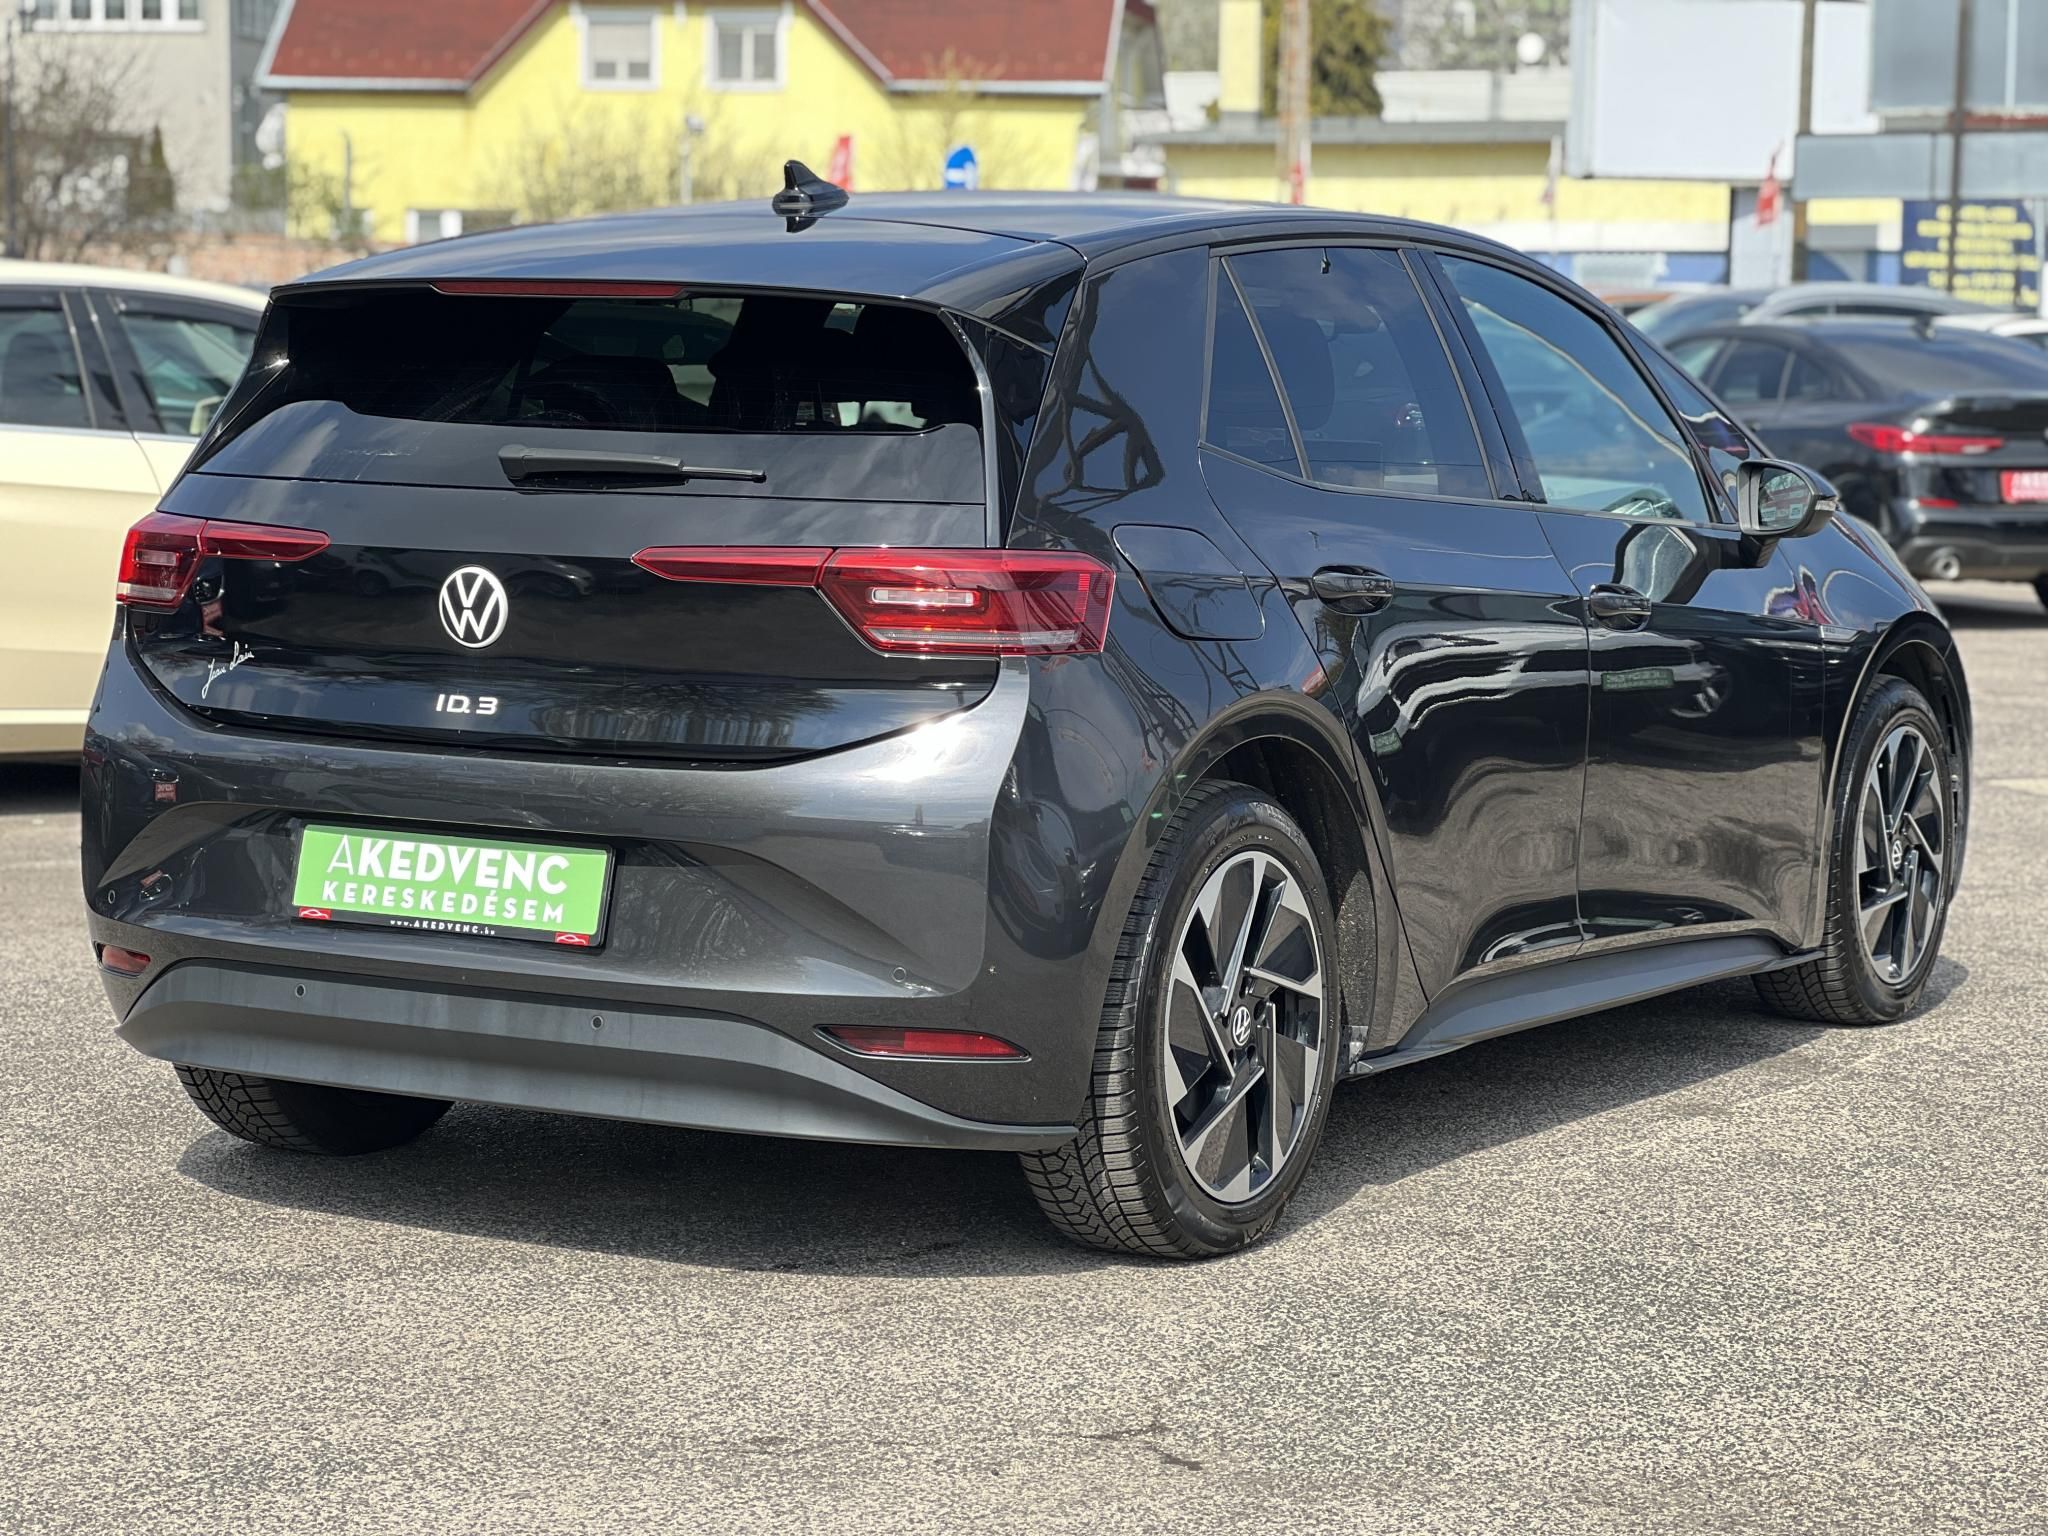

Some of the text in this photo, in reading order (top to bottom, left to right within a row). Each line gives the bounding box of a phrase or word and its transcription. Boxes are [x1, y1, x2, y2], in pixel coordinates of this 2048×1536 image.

[435, 693, 498, 715] ID.3
[326, 834, 570, 896] AKEDVENC
[321, 880, 565, 925] KERESKEDÉSEM
[390, 919, 496, 936] www.AKEDVENC.hu
